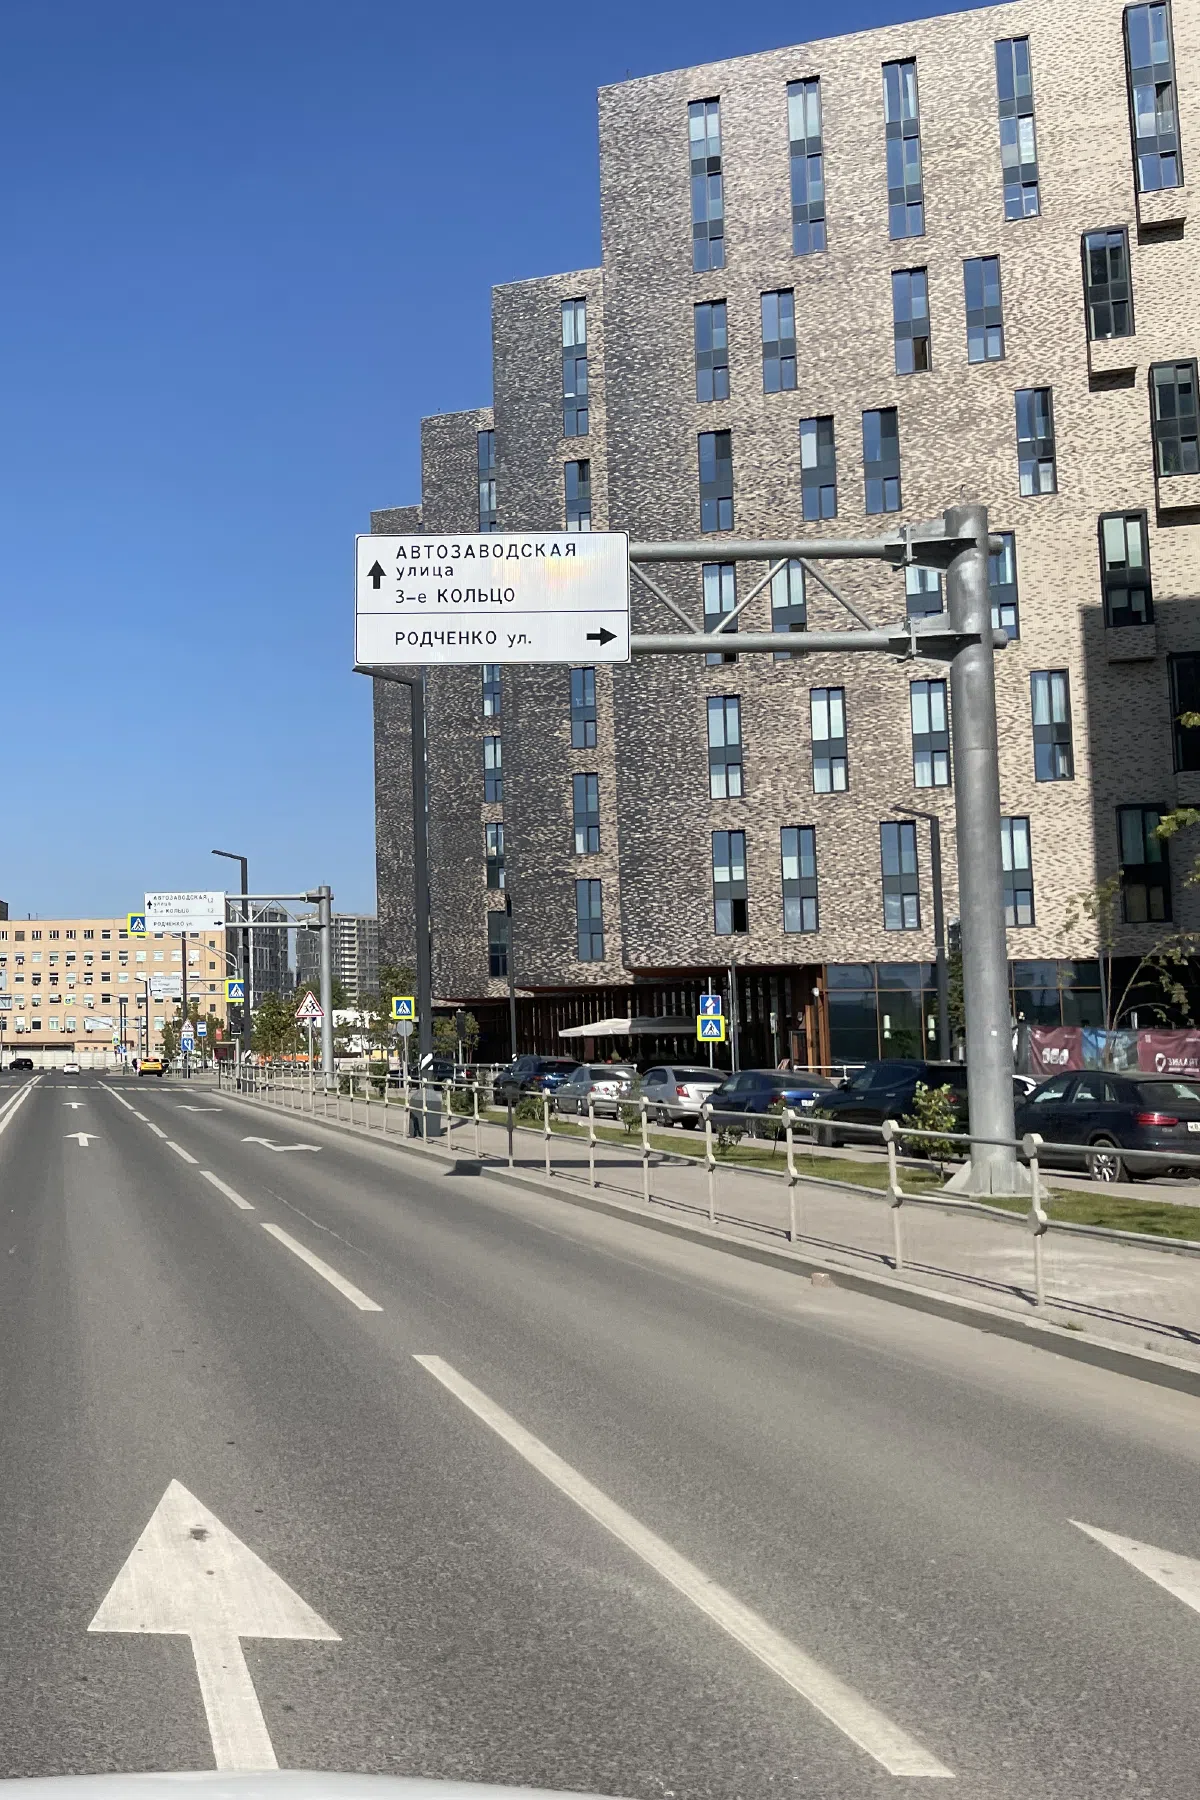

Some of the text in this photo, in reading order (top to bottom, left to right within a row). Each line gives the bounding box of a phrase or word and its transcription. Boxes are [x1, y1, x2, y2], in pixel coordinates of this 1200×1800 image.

[395, 543, 576, 560] АВТОЗАВОДСКАЯ
[395, 564, 455, 580] улица
[395, 588, 515, 604] 3-е КОЛЬЦО
[395, 631, 532, 648] РОДЧЕНКО ул.
